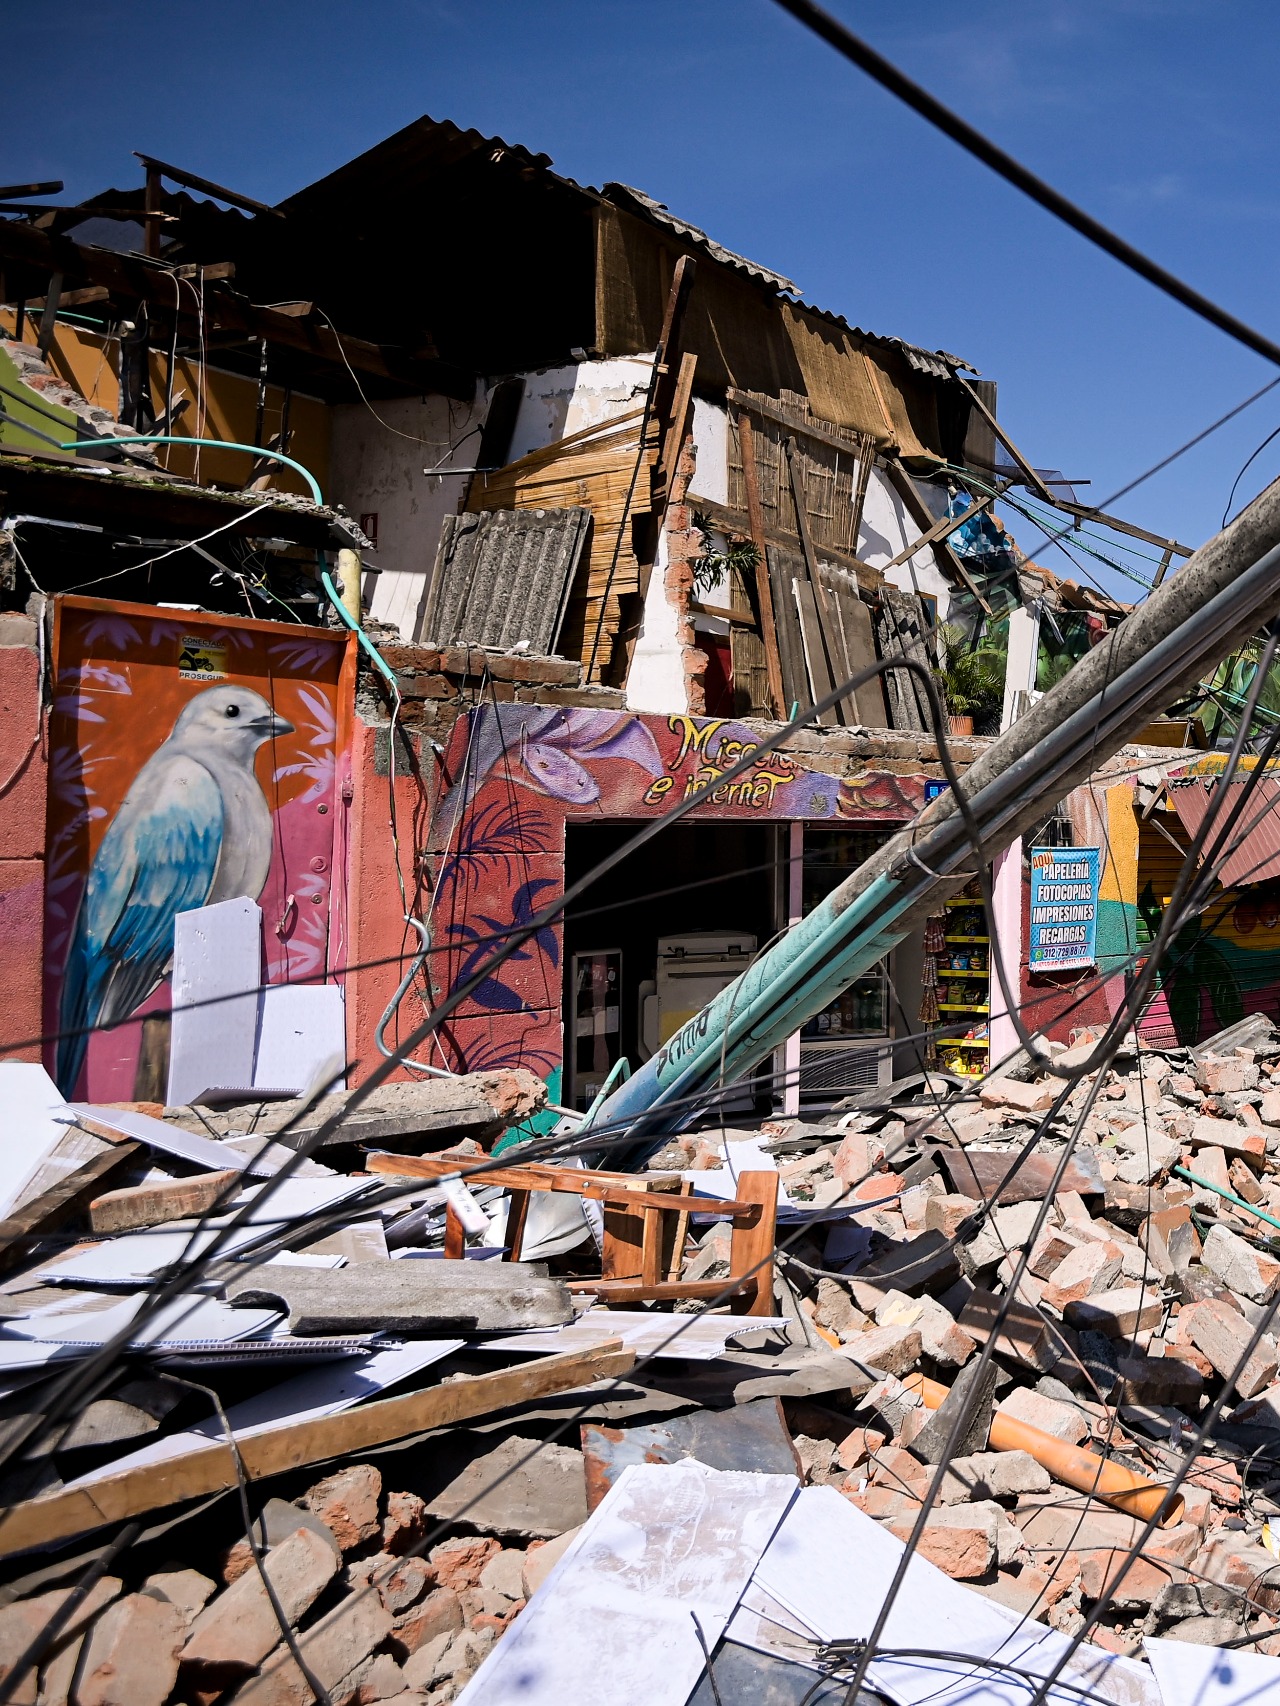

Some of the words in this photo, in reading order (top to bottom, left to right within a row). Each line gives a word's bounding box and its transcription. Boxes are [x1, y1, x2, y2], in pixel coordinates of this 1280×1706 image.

[643, 776, 674, 805] e
[1042, 857, 1089, 880] PAPELERÍA
[1037, 883, 1092, 902] FOTOCOPIAS
[1032, 904, 1094, 924] IMPRESIONES
[1039, 925, 1086, 945] RECARGAS
[1043, 949, 1056, 958] 312
[1079, 946, 1087, 954] 77
